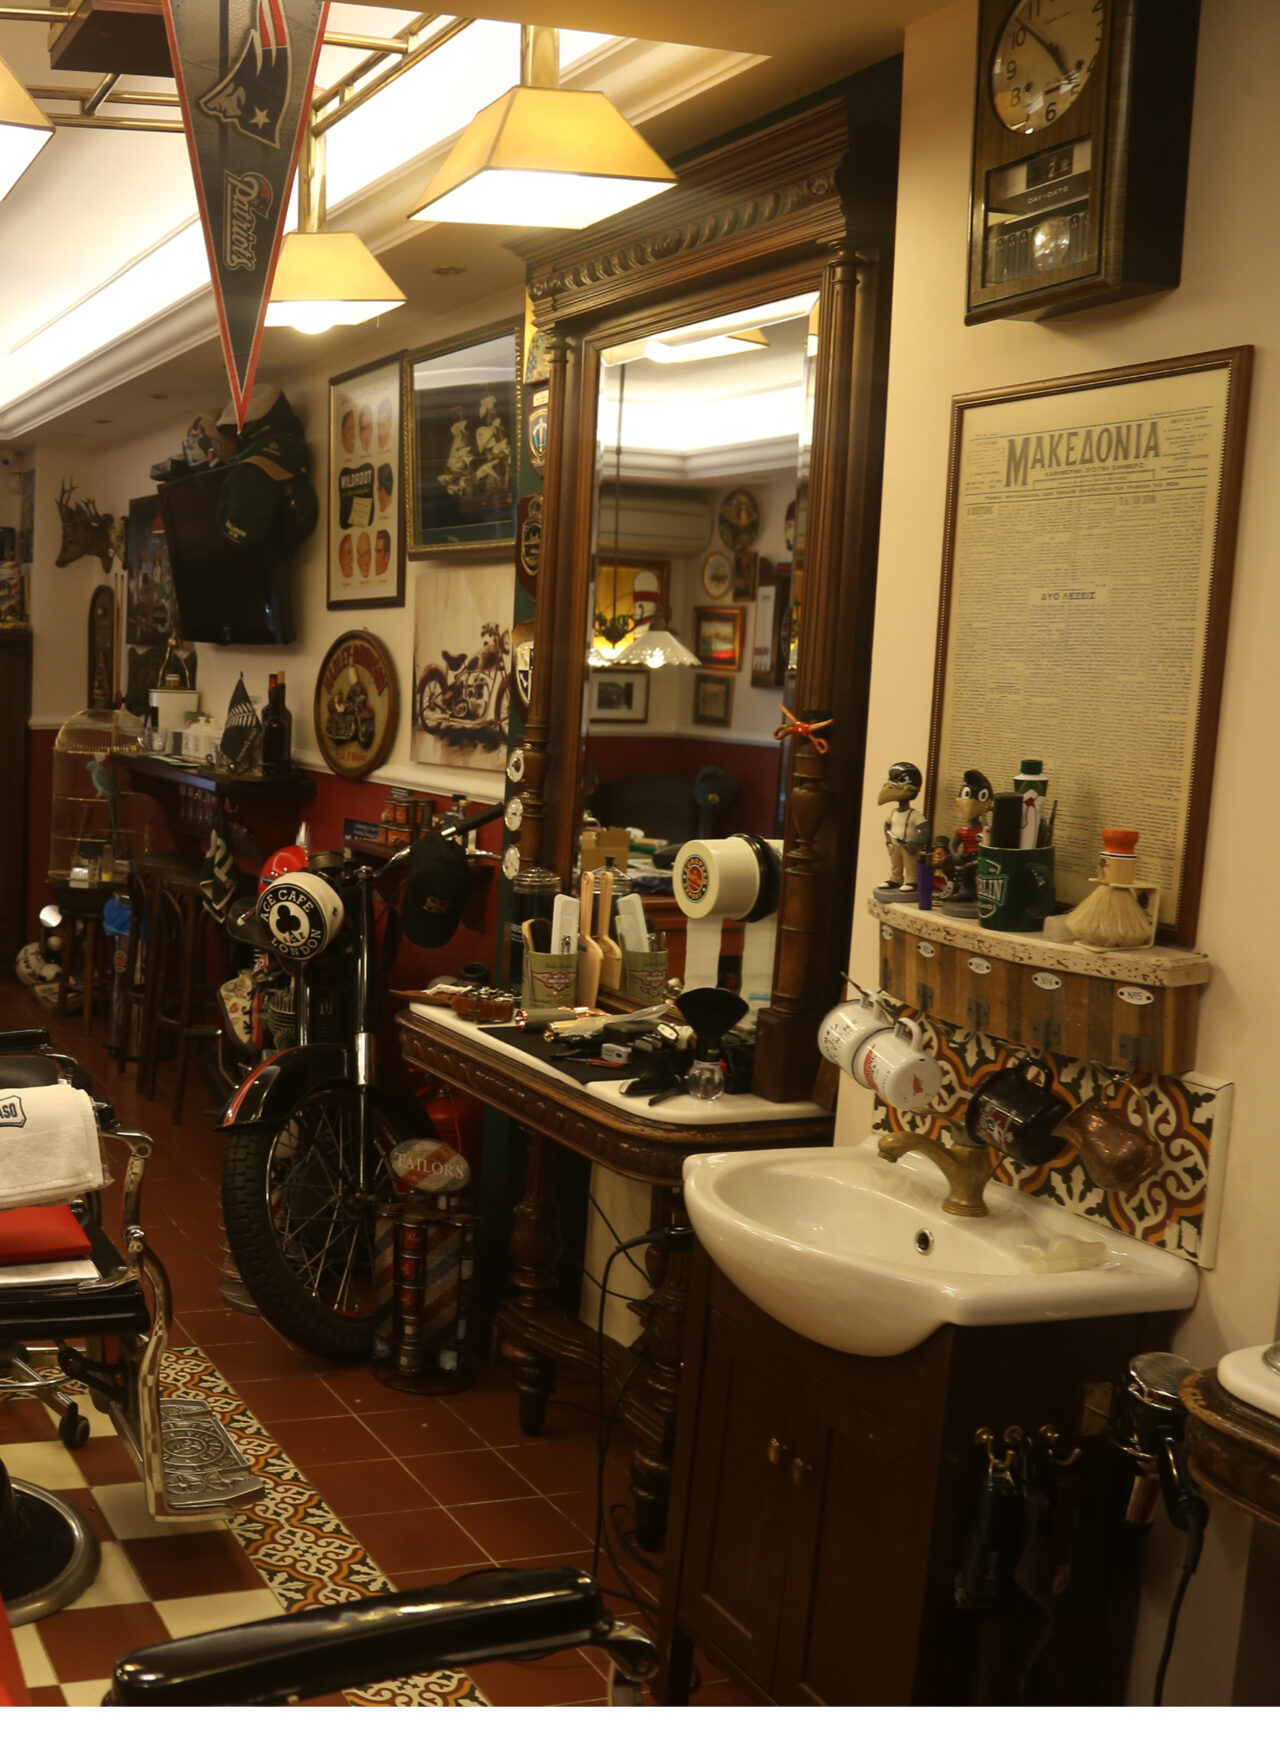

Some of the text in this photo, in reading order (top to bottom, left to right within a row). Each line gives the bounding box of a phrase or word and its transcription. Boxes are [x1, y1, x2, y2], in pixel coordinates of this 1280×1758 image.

[1010, 27, 1026, 50] 10
[1006, 60, 1017, 80] 9
[1009, 87, 1021, 108] 8
[1045, 101, 1057, 122] 6
[226, 175, 260, 268] Patriots
[261, 889, 314, 922] ACE CAFE
[272, 929, 322, 956] LONDON
[395, 1152, 465, 1179] TAILORS
